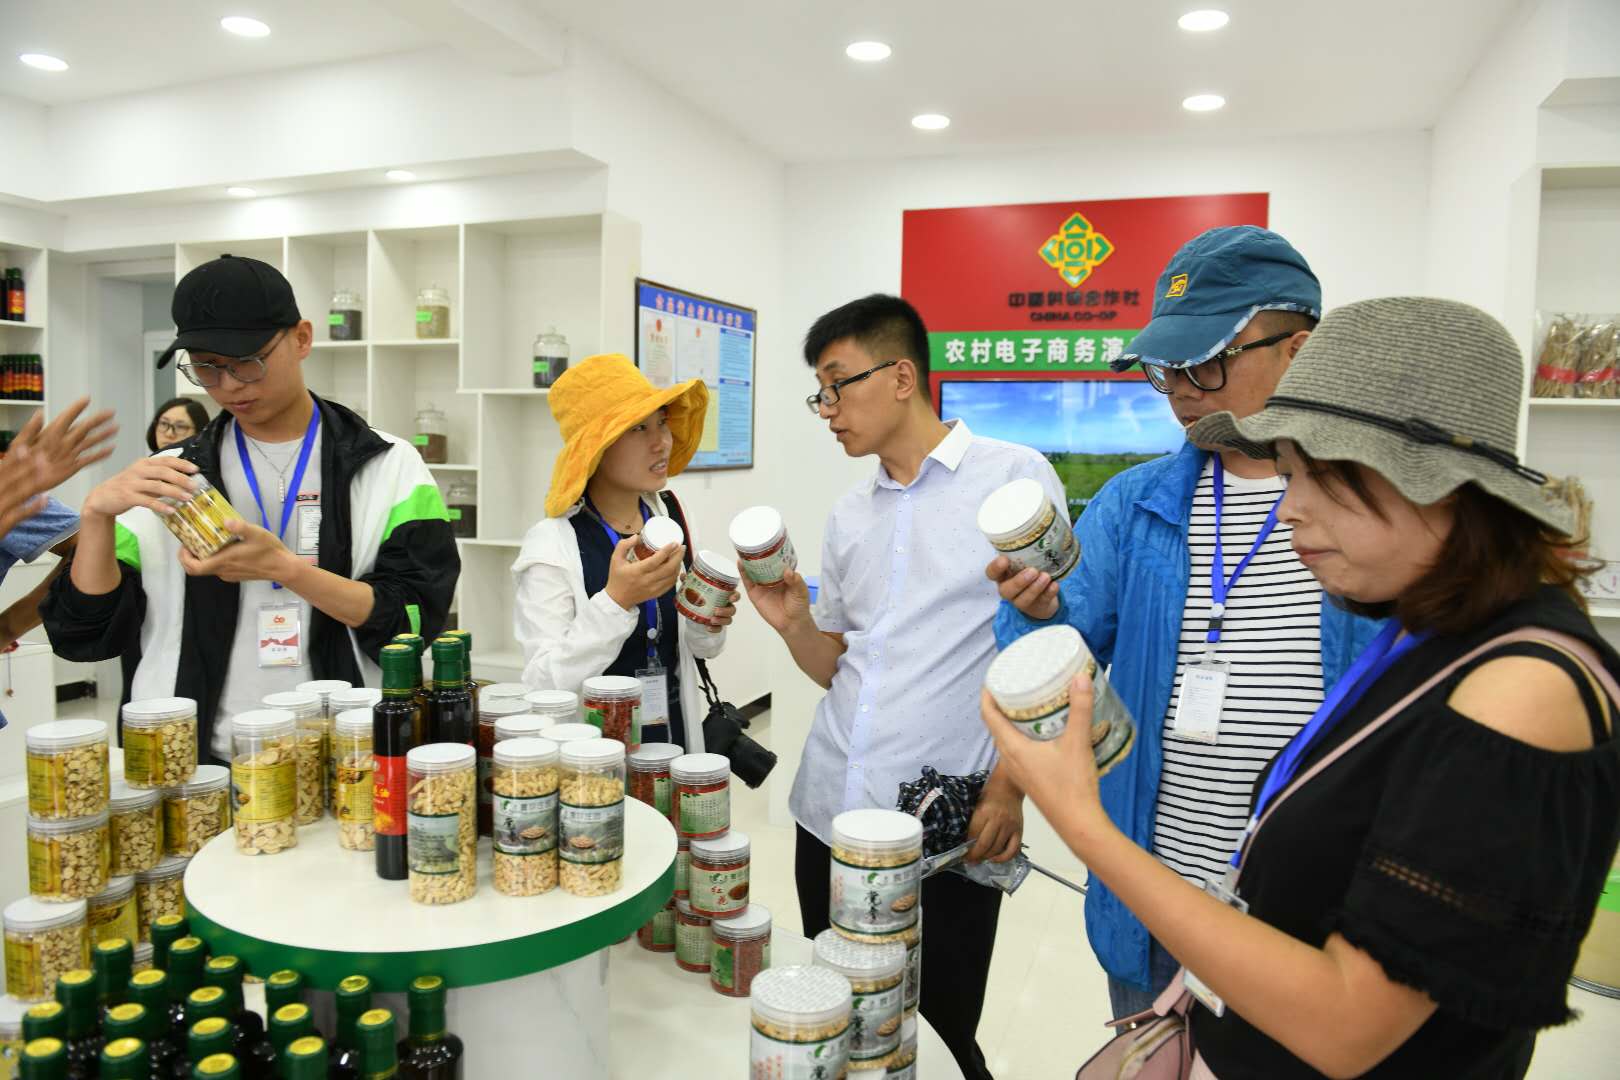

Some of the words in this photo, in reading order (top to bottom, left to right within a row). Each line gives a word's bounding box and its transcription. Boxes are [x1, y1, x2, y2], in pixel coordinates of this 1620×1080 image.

[1029, 311, 1071, 321] CHINA
[1073, 311, 1118, 321] CO-OP
[945, 337, 1136, 364] 农村电子商务演
